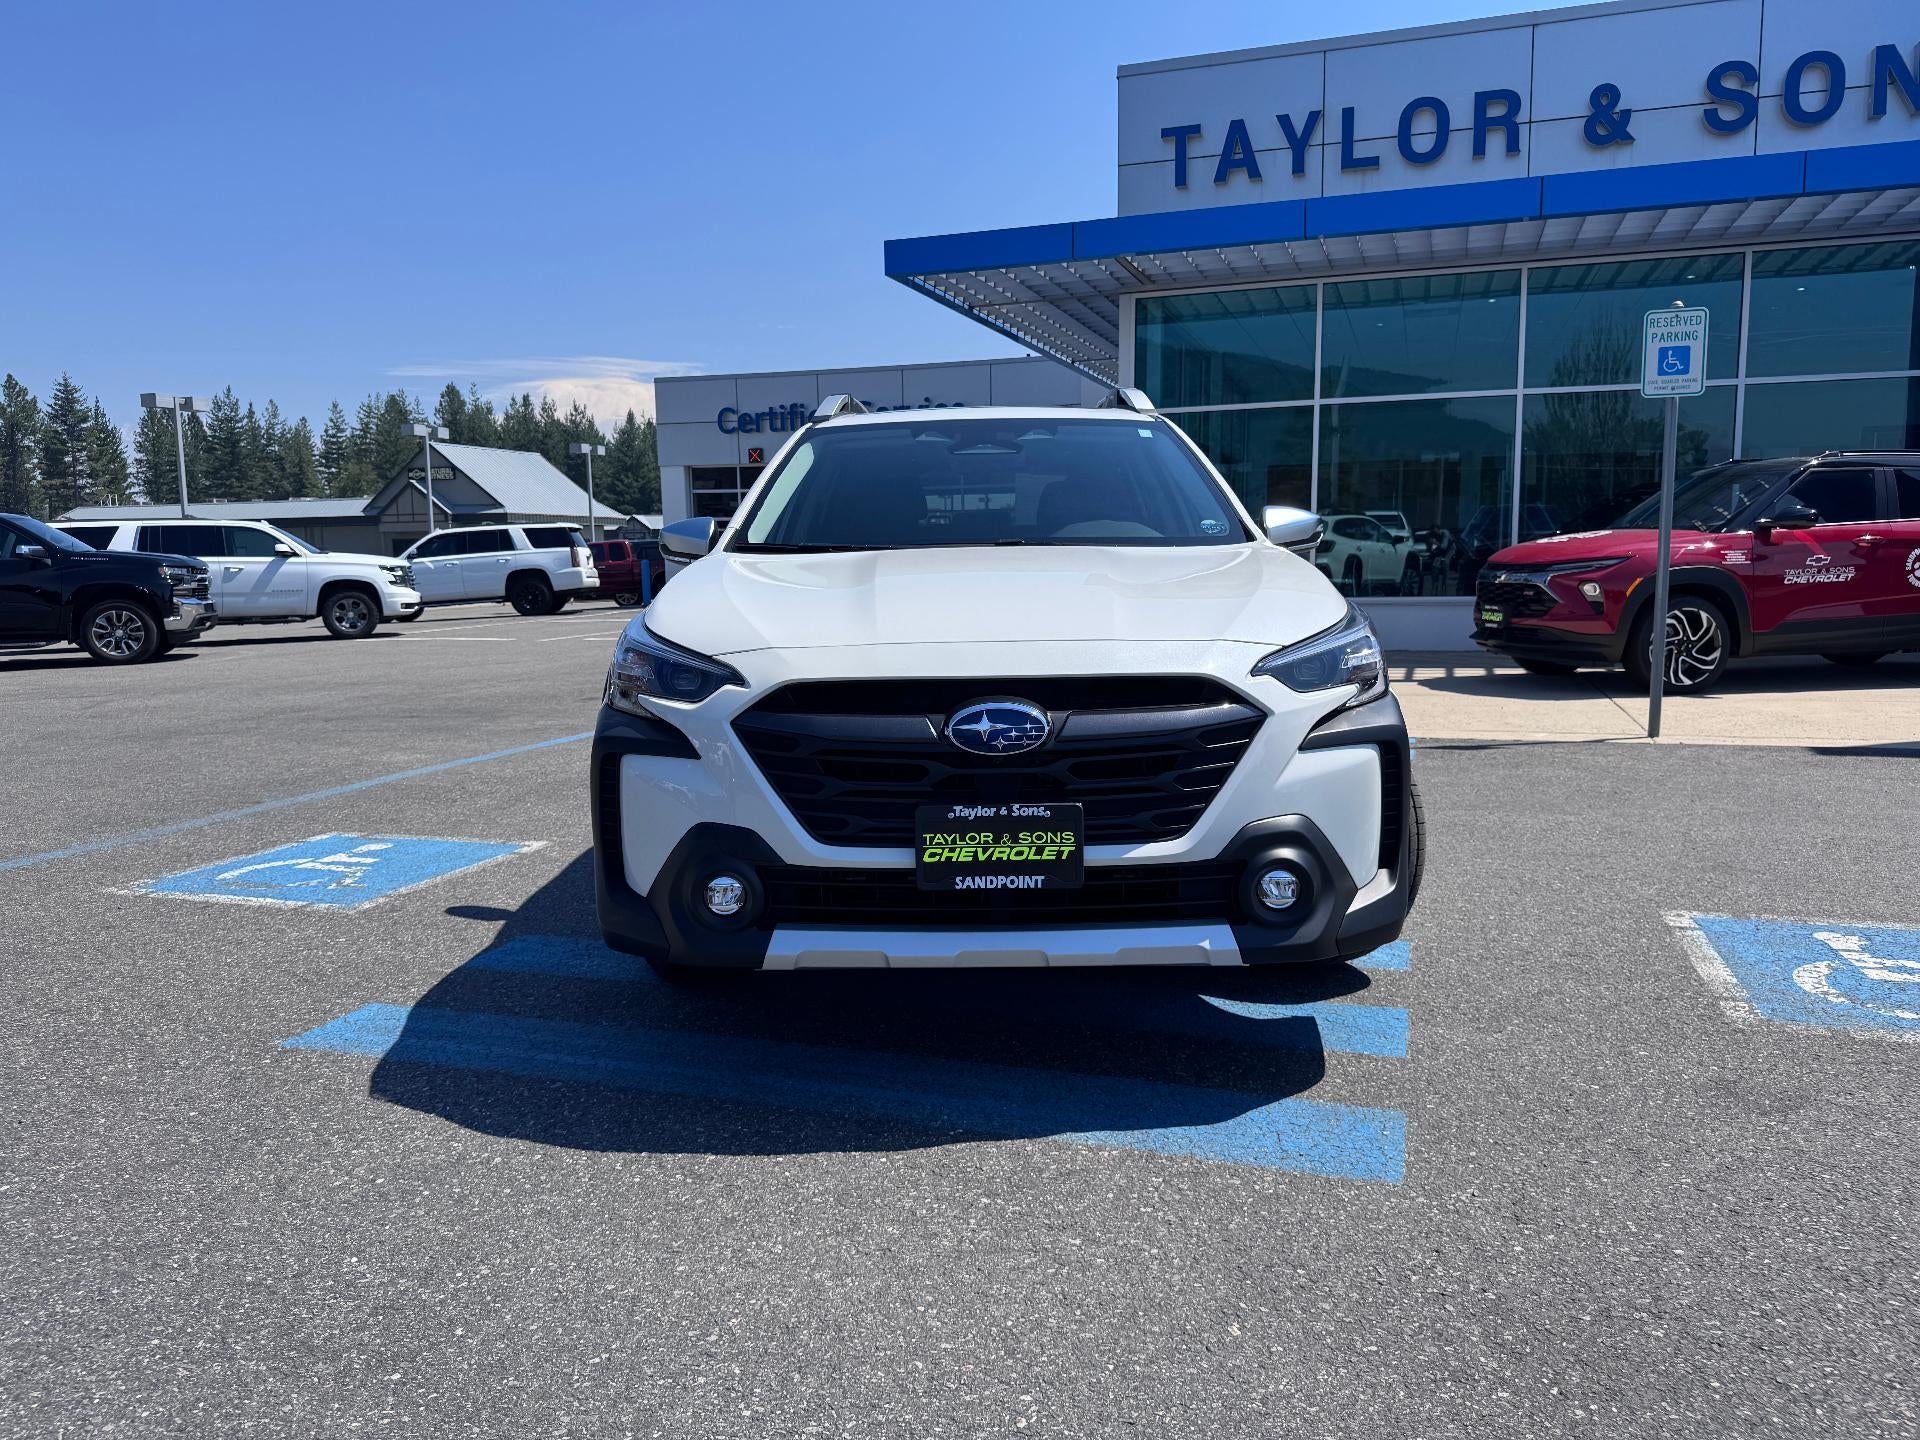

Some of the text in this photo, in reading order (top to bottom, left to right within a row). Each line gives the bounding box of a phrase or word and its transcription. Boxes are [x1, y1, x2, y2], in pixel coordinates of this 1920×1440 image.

[1161, 41, 1920, 188] TAYLOR & SON
[1650, 315, 1702, 328] RESERVED
[1651, 330, 1698, 343] PARKING
[717, 402, 816, 435] Certifi
[1905, 547, 1920, 570] SANDPO
[1829, 566, 1855, 574] SONS
[1784, 573, 1855, 584] CHEVROLET
[953, 805, 996, 820] Taylor
[1000, 806, 1008, 815] &
[923, 832, 1075, 846] TAYLOR & SONS
[923, 846, 1075, 863] CHEVROLET
[955, 875, 1046, 890] SANDPOINT
